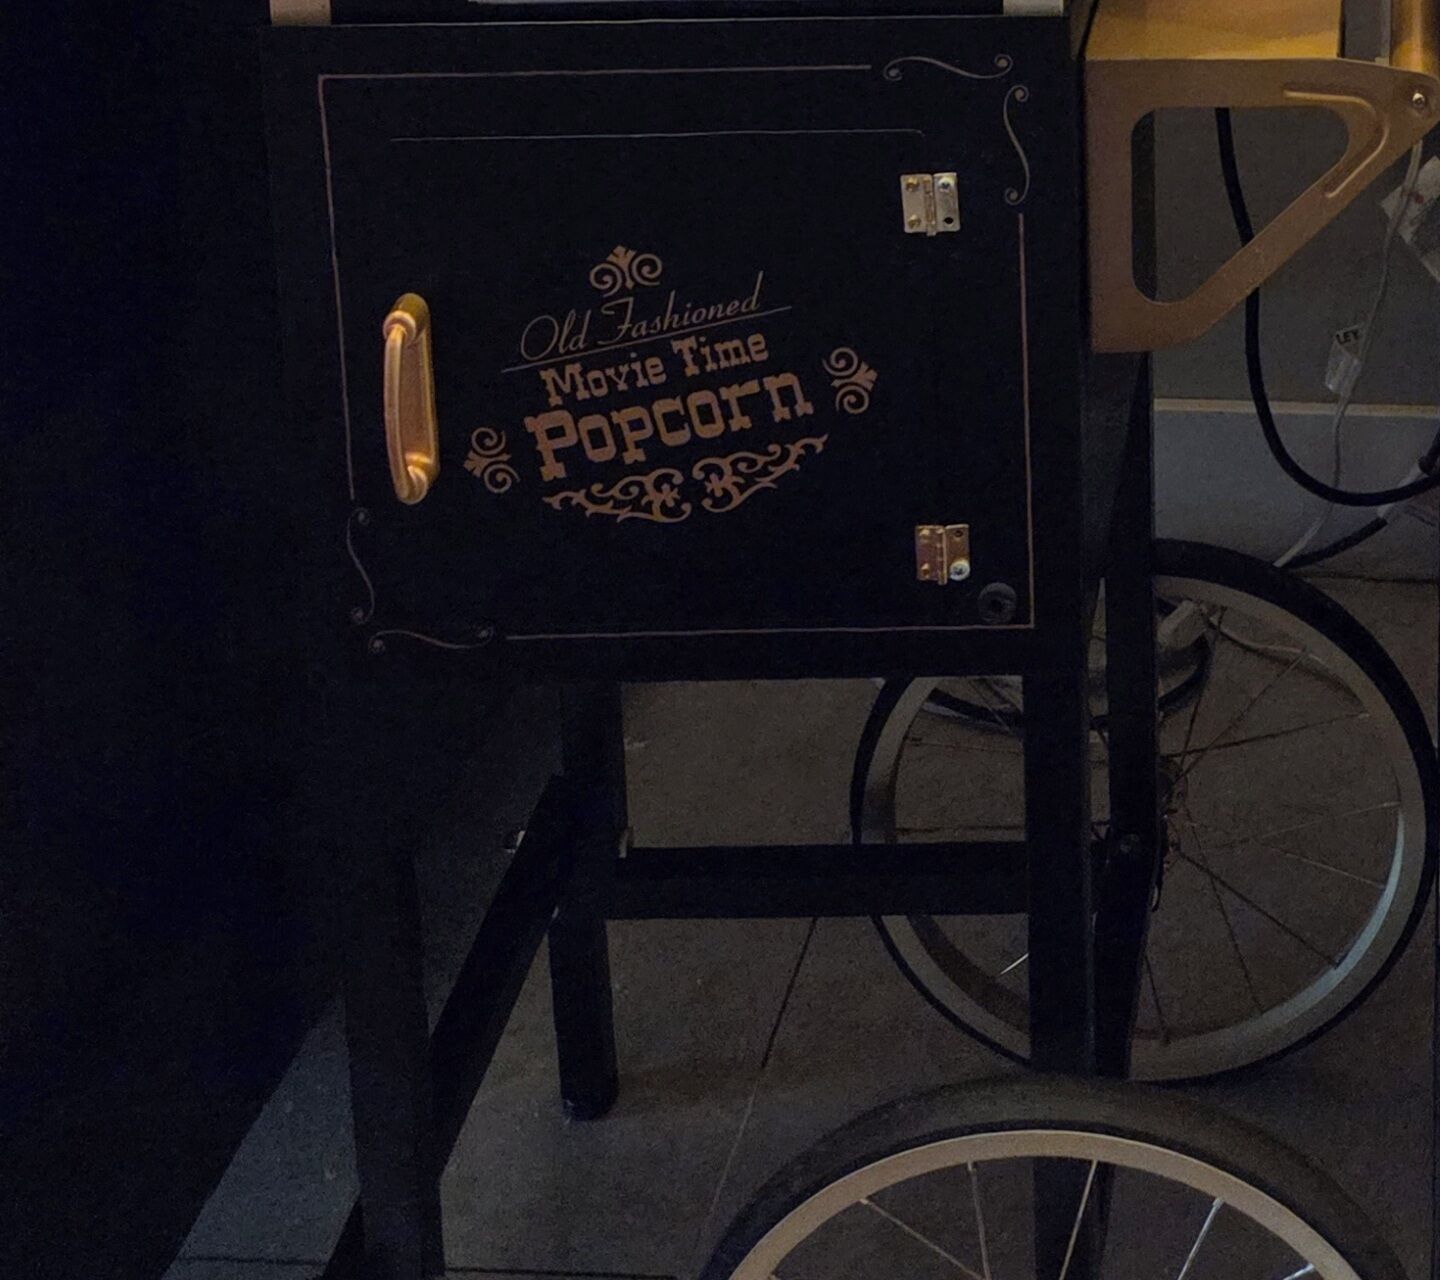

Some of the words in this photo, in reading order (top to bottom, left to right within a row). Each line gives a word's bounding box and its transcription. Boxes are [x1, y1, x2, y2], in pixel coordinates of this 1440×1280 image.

[520, 308, 592, 361] Old
[597, 270, 764, 345] Fashioned
[539, 352, 667, 407] Movie
[671, 332, 769, 378] Time
[523, 372, 814, 482] Popcorn
